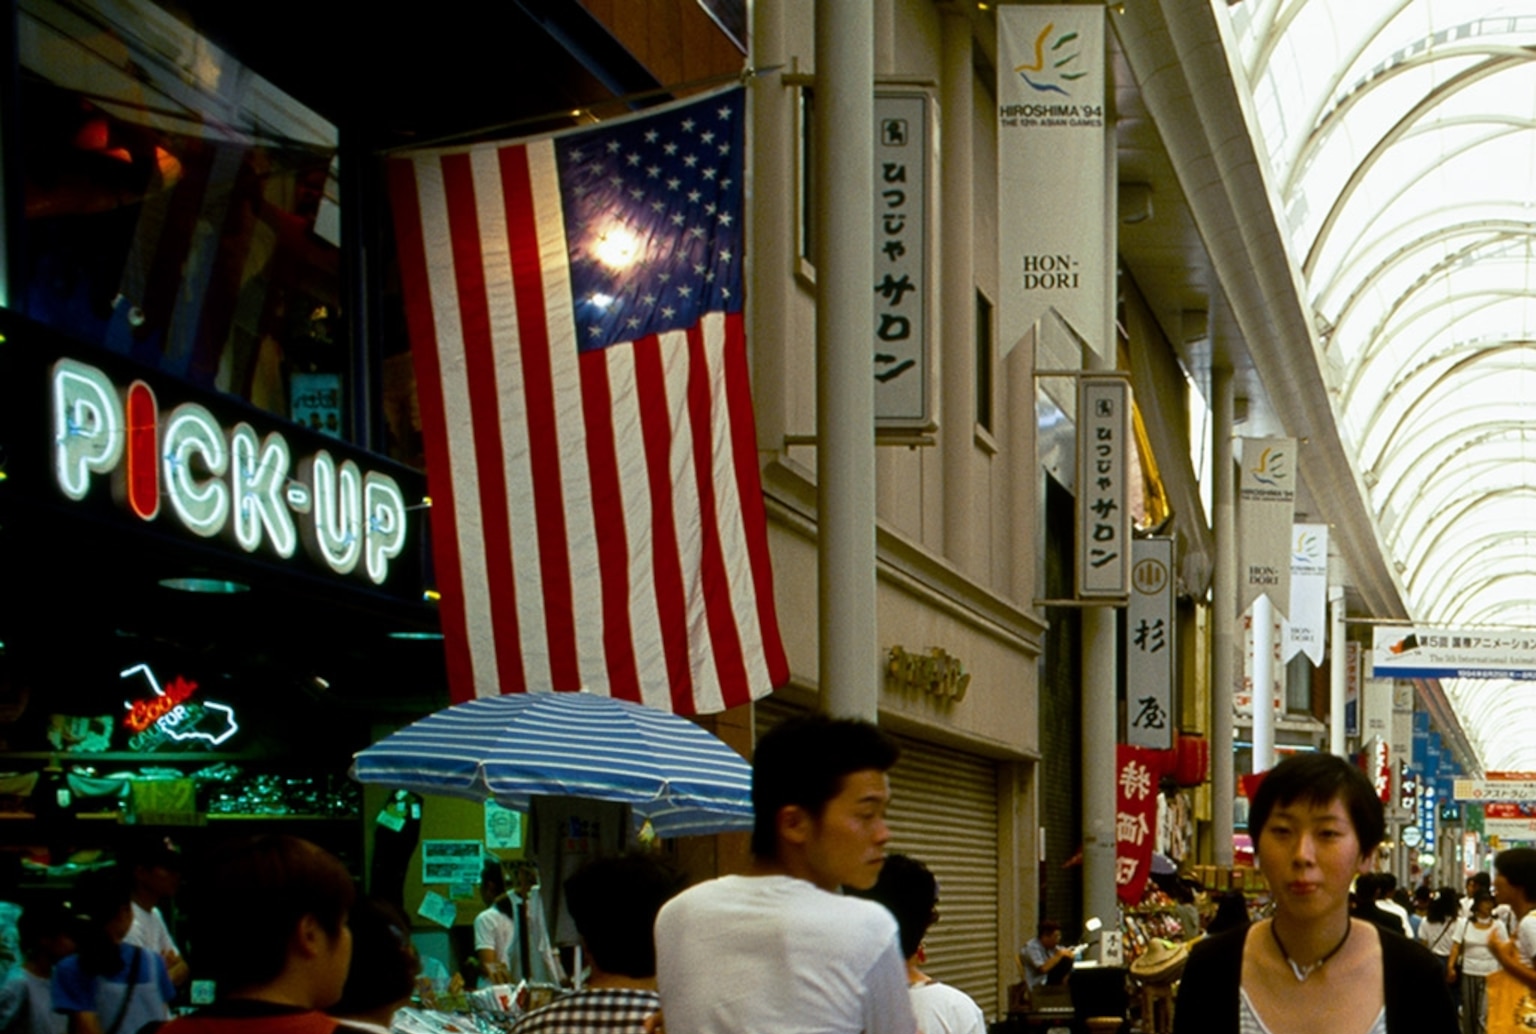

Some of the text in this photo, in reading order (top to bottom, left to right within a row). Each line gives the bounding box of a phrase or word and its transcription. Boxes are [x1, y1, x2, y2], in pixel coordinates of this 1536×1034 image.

[1000, 105, 1079, 117] HIROSHIMA
[1069, 119, 1102, 127] GAMES
[1023, 255, 1079, 272] HON-
[874, 162, 916, 382] ひつじやサロン
[1023, 273, 1079, 289] DORI
[52, 357, 407, 585] PICK-UP
[1091, 426, 1118, 568] ひつじやサロン
[1249, 576, 1279, 584] DORI
[1420, 635, 1449, 648] 第5回
[1430, 654, 1446, 662] The
[1457, 655, 1507, 664] International
[1132, 618, 1166, 730] 杉屋
